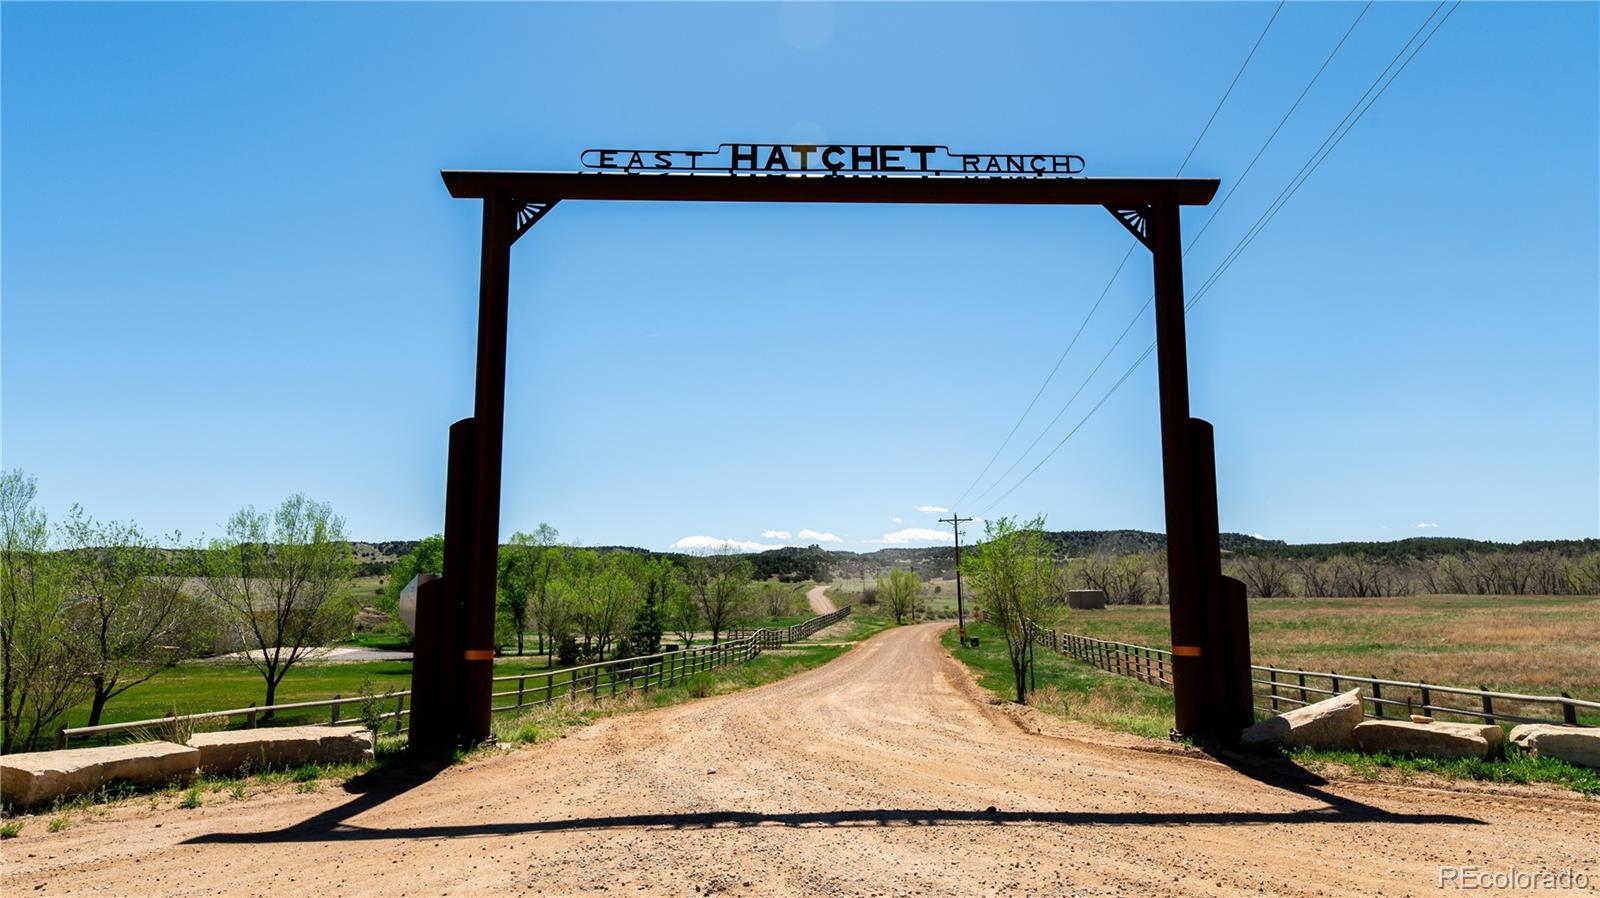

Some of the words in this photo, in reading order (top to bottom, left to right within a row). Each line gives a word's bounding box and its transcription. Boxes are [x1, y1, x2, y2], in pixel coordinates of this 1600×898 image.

[600, 151, 703, 169] EAST
[732, 145, 936, 171] HATCHET
[962, 155, 1071, 172] RANCH
